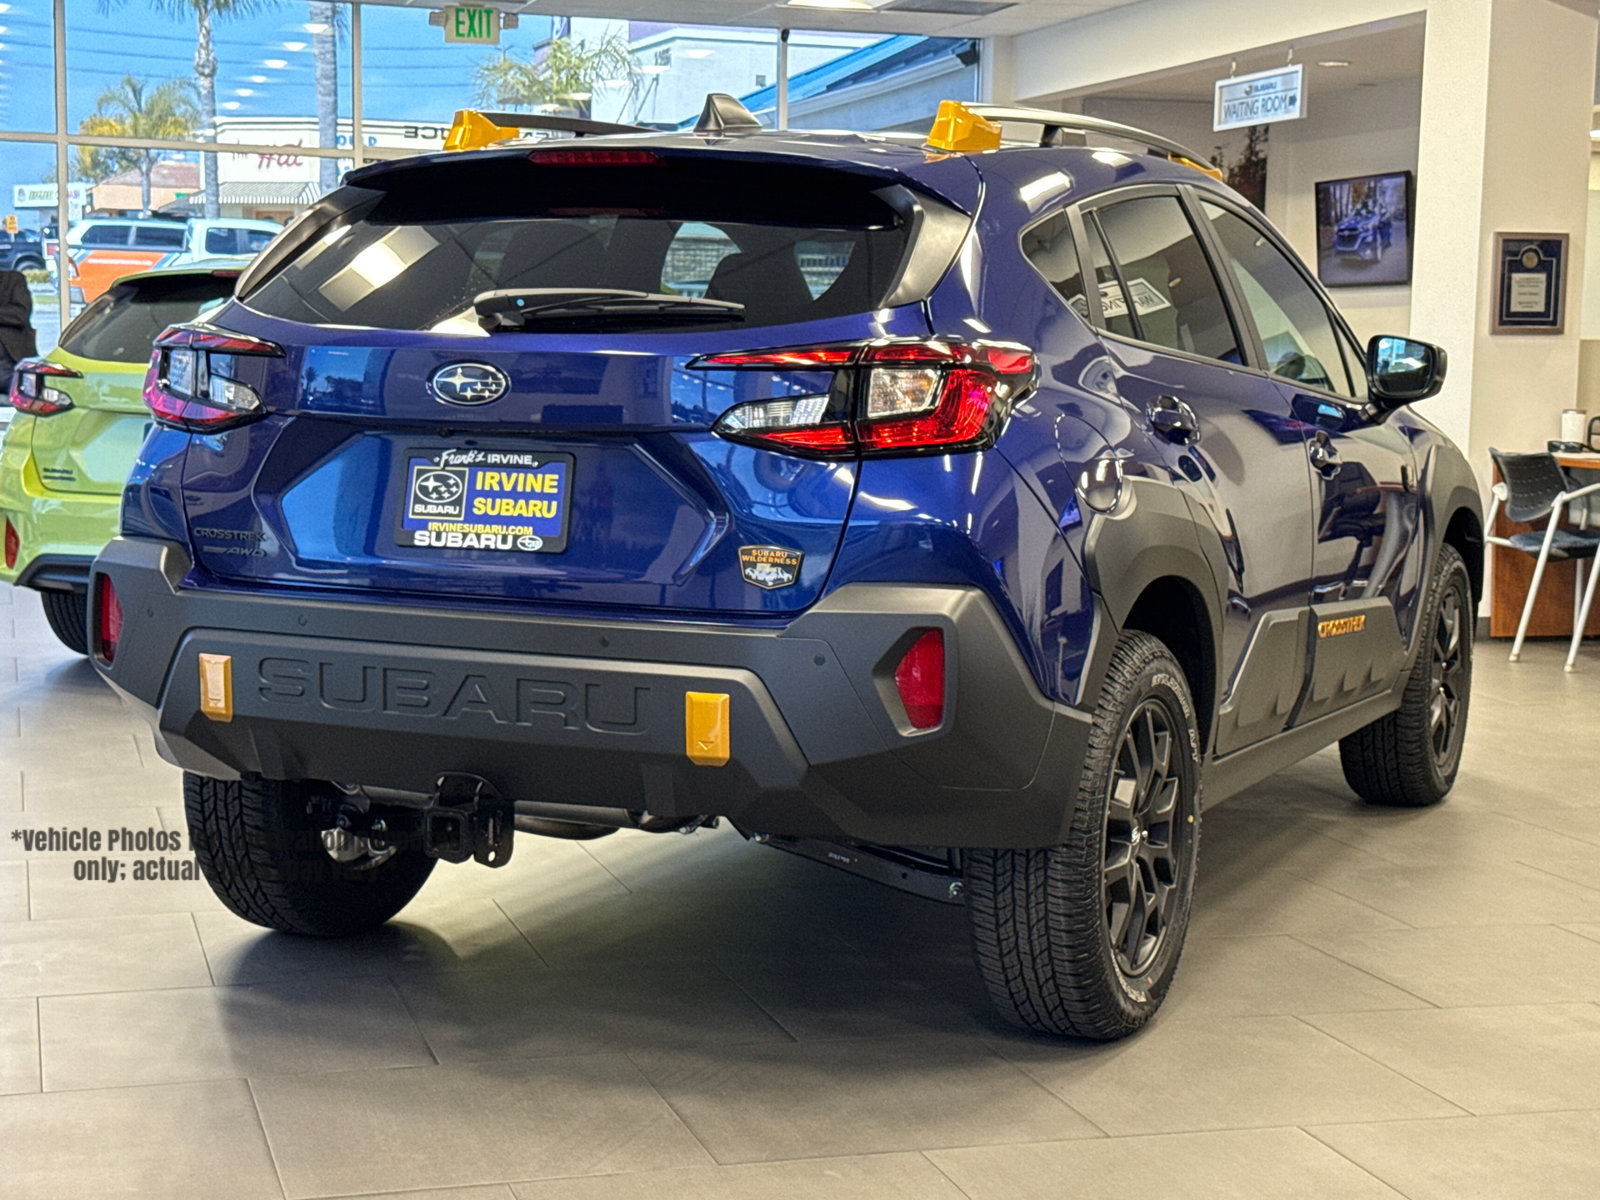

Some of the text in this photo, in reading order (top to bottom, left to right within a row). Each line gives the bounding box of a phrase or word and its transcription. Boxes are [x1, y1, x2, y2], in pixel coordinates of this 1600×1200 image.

[455, 8, 493, 38] EXIT
[1223, 94, 1288, 120] WAITING ROOM
[487, 453, 533, 465] IRVINE
[476, 471, 560, 493] IRVINE
[413, 504, 460, 515] SUBARU
[472, 497, 557, 519] SUBARU
[193, 527, 267, 542] CROSSTREK
[428, 522, 534, 536] IRVINESUBARU.COM
[413, 530, 514, 551] SUBARU
[742, 554, 796, 565] WILDERNESS
[752, 549, 787, 558] SUBARU
[258, 656, 650, 735] SUBARU
